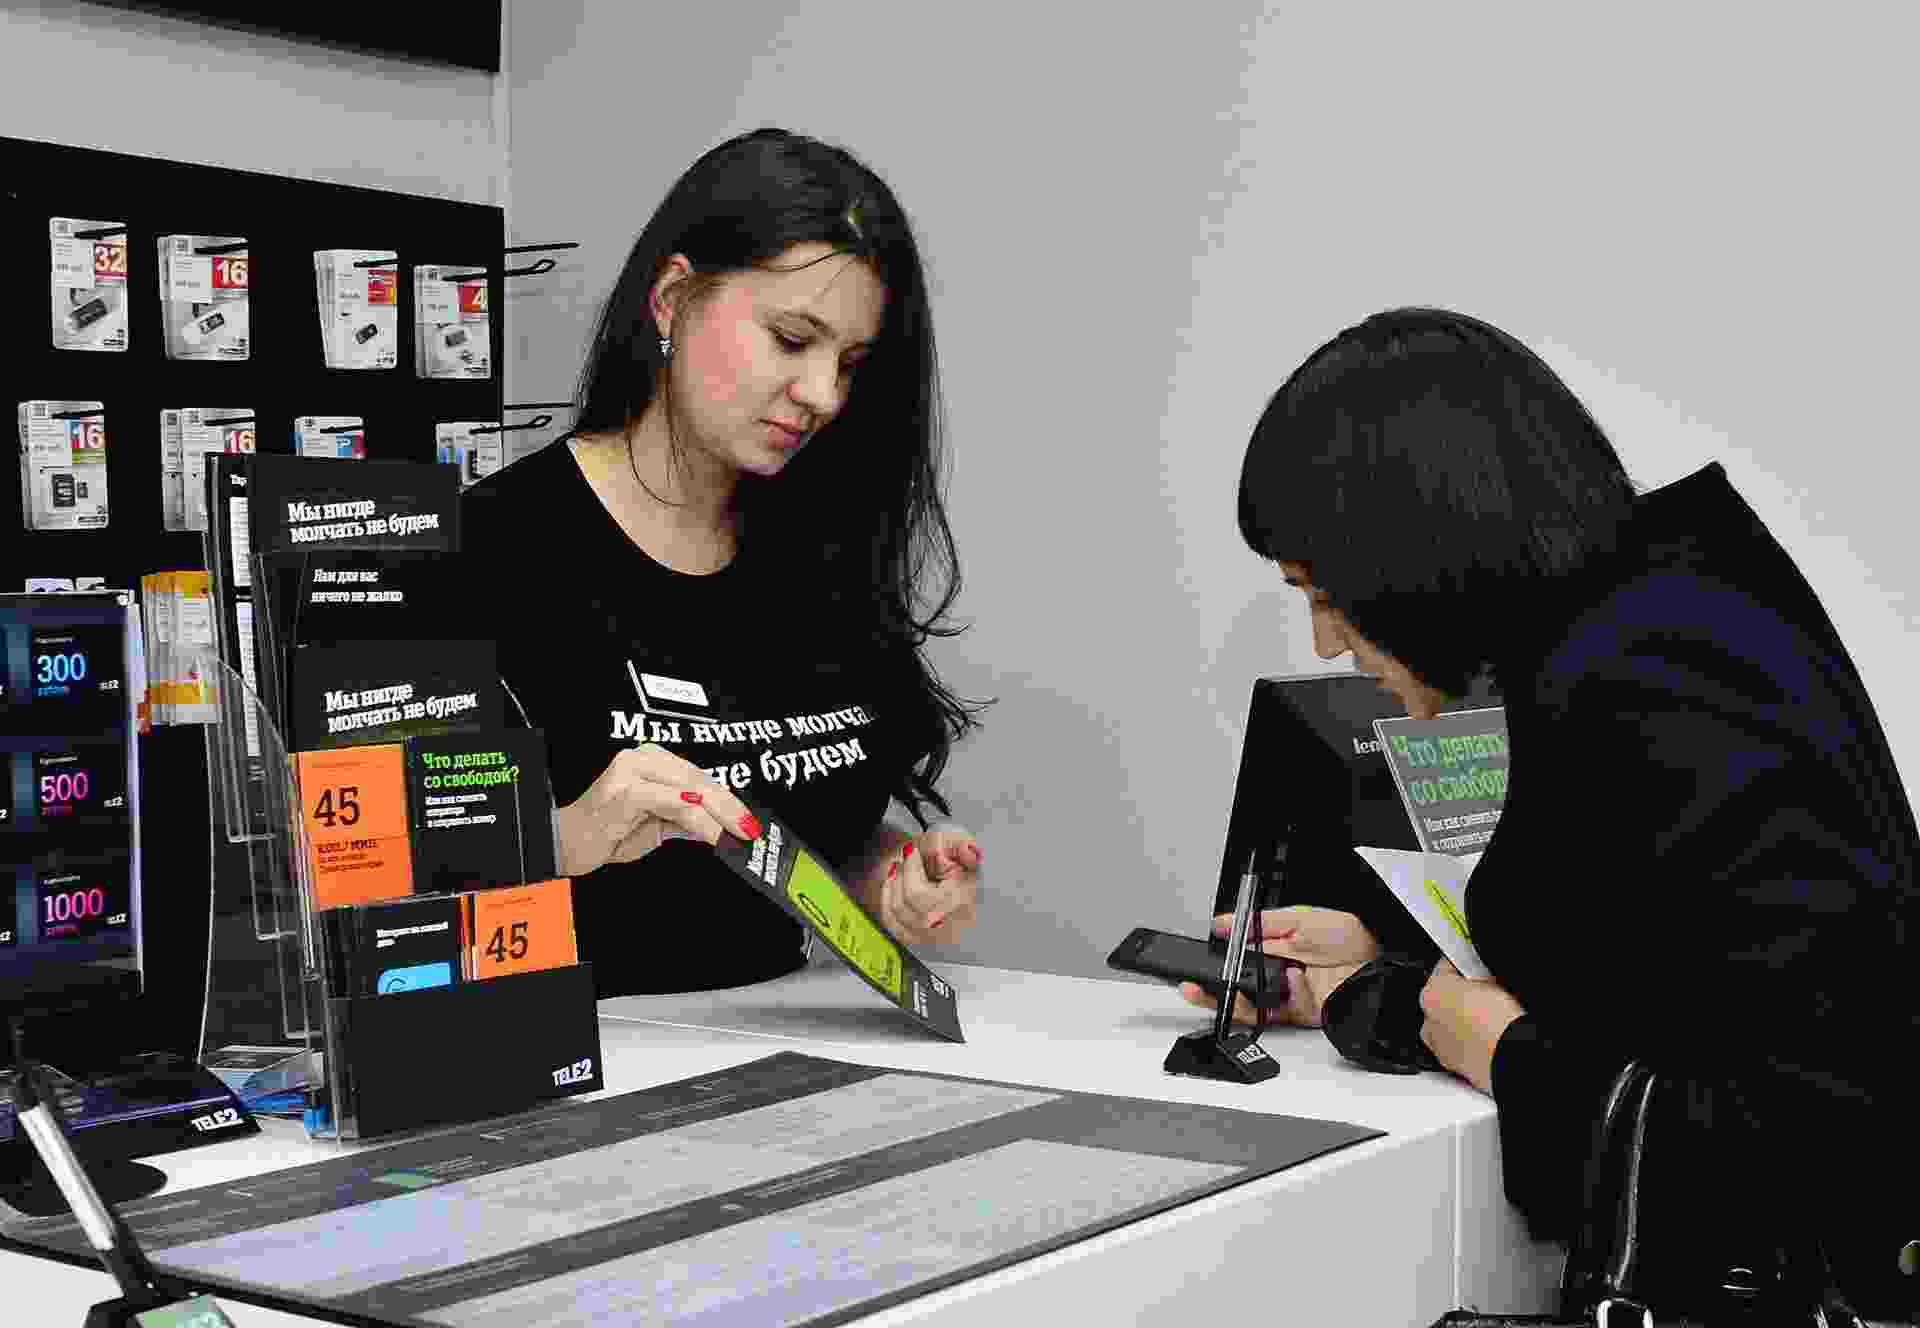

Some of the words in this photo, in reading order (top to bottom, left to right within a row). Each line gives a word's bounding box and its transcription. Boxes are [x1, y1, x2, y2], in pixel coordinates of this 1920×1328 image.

[96, 246, 125, 273] 32
[217, 259, 247, 286] 16
[74, 422, 104, 448] 16
[288, 502, 321, 522] Мы
[323, 500, 376, 520] нигде
[290, 522, 364, 543] молчать
[366, 519, 387, 535] не
[388, 513, 439, 536] будем
[37, 653, 86, 682] 300
[325, 690, 359, 712] Мы
[360, 684, 413, 705] нигде
[328, 707, 402, 733] молчать
[403, 702, 425, 719] не
[426, 693, 478, 718] будем
[610, 711, 682, 743] Мы
[690, 719, 783, 745] нигде
[421, 752, 450, 769] Что
[453, 751, 507, 770] делать
[760, 738, 867, 791] будем
[41, 772, 88, 802] 500
[424, 775, 441, 788] со
[443, 766, 520, 787] свободой?
[314, 787, 360, 827] 45
[44, 888, 103, 923] 1000
[487, 921, 529, 963] 45
[191, 1108, 244, 1131] TELE2
